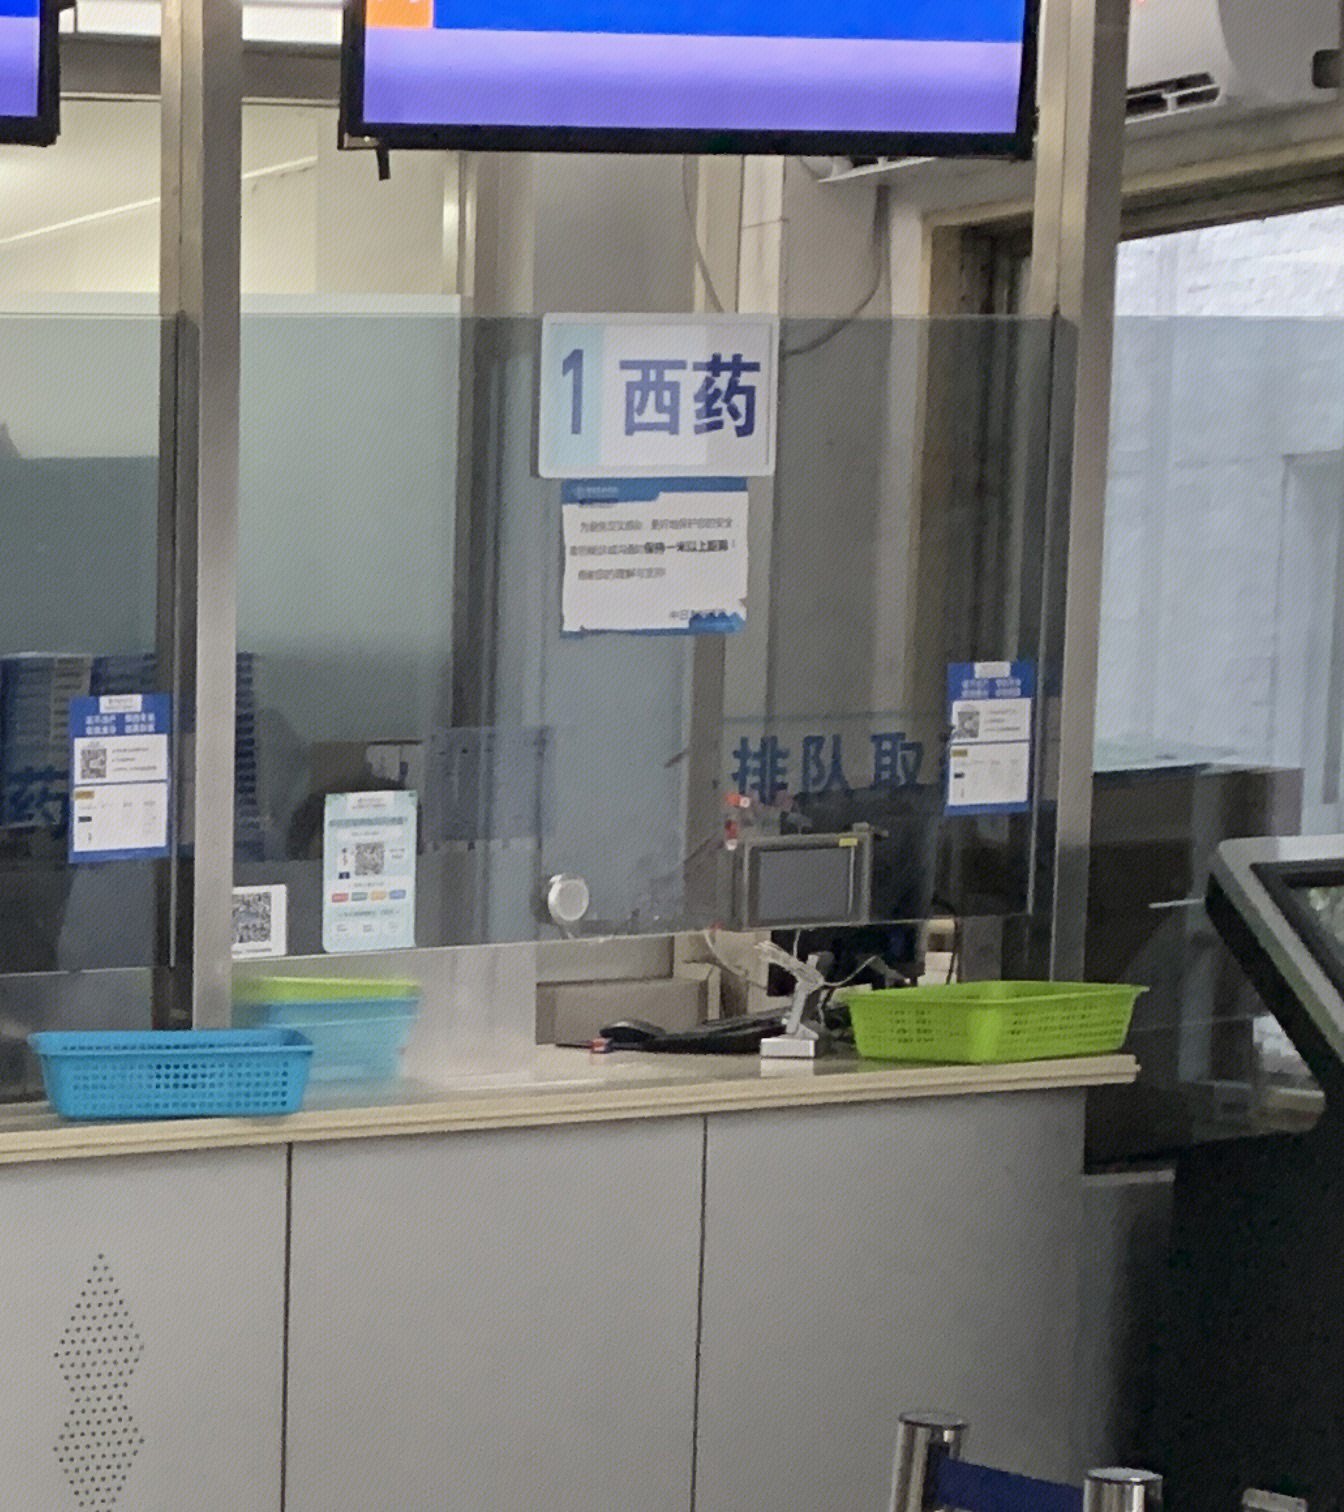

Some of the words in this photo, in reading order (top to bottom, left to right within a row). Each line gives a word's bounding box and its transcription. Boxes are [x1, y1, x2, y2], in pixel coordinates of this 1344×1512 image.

[562, 349, 584, 435] 1
[619, 352, 760, 438] 西药
[730, 731, 952, 806] 排队取
